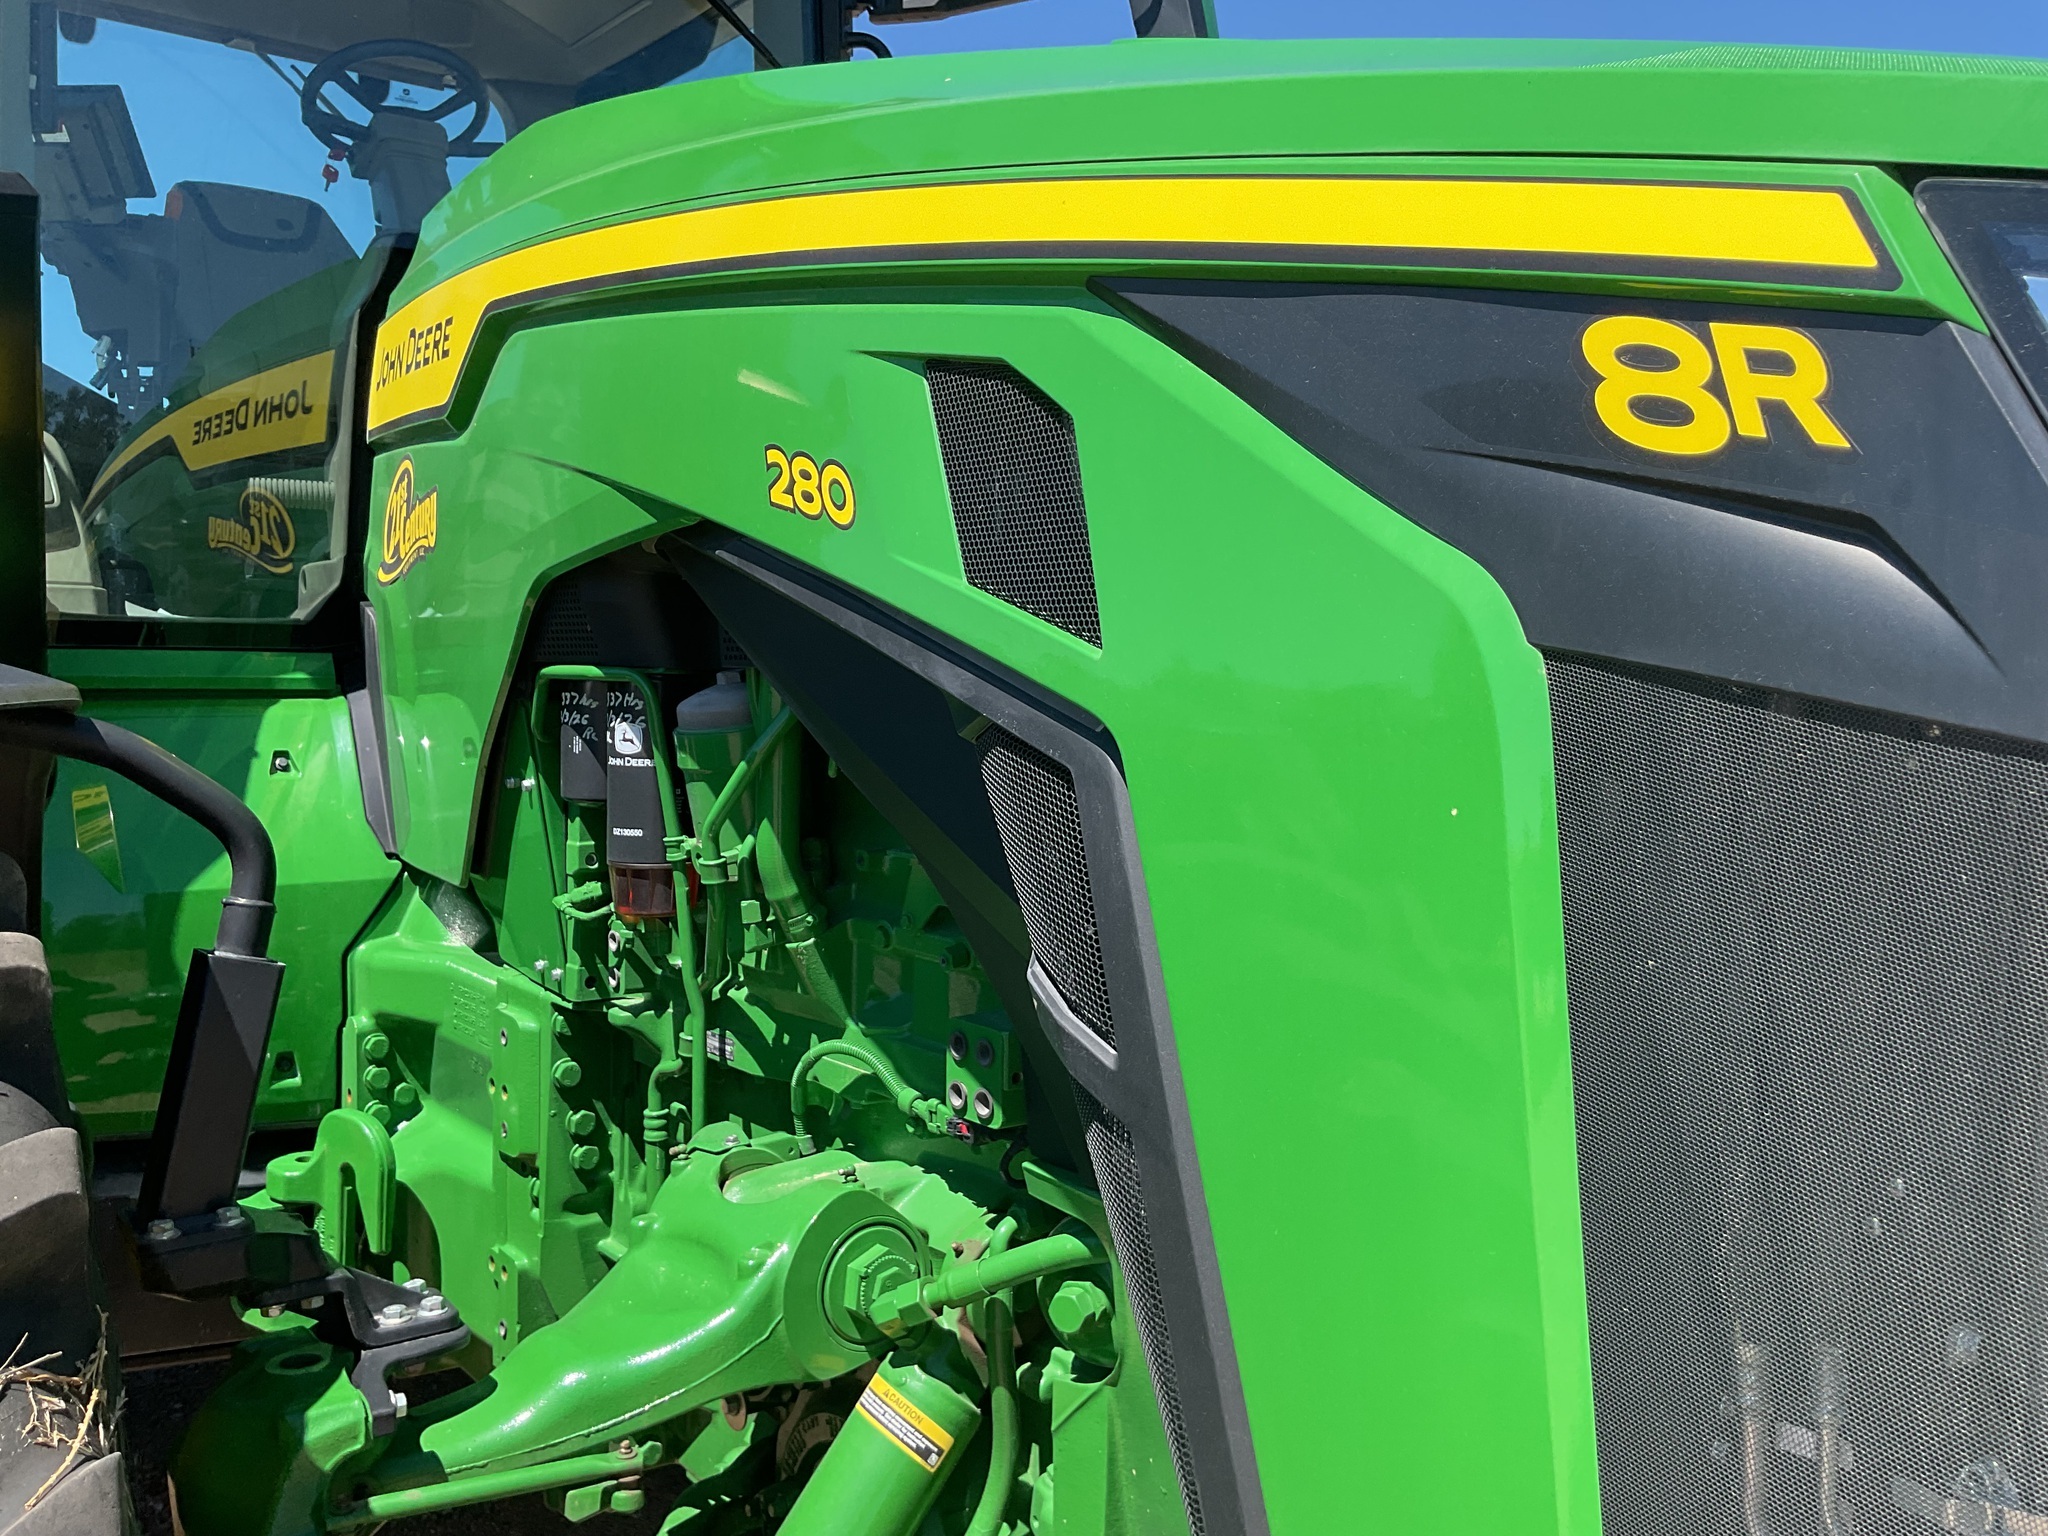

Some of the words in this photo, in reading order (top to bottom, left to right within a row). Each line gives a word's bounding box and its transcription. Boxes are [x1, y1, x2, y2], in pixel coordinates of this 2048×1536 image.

[376, 341, 405, 391] JOHN
[405, 316, 453, 375] DEERE
[1582, 316, 1851, 454] 8R
[764, 444, 856, 530] 280
[608, 756, 624, 766] JOHN
[888, 1393, 925, 1425] CAUTION
